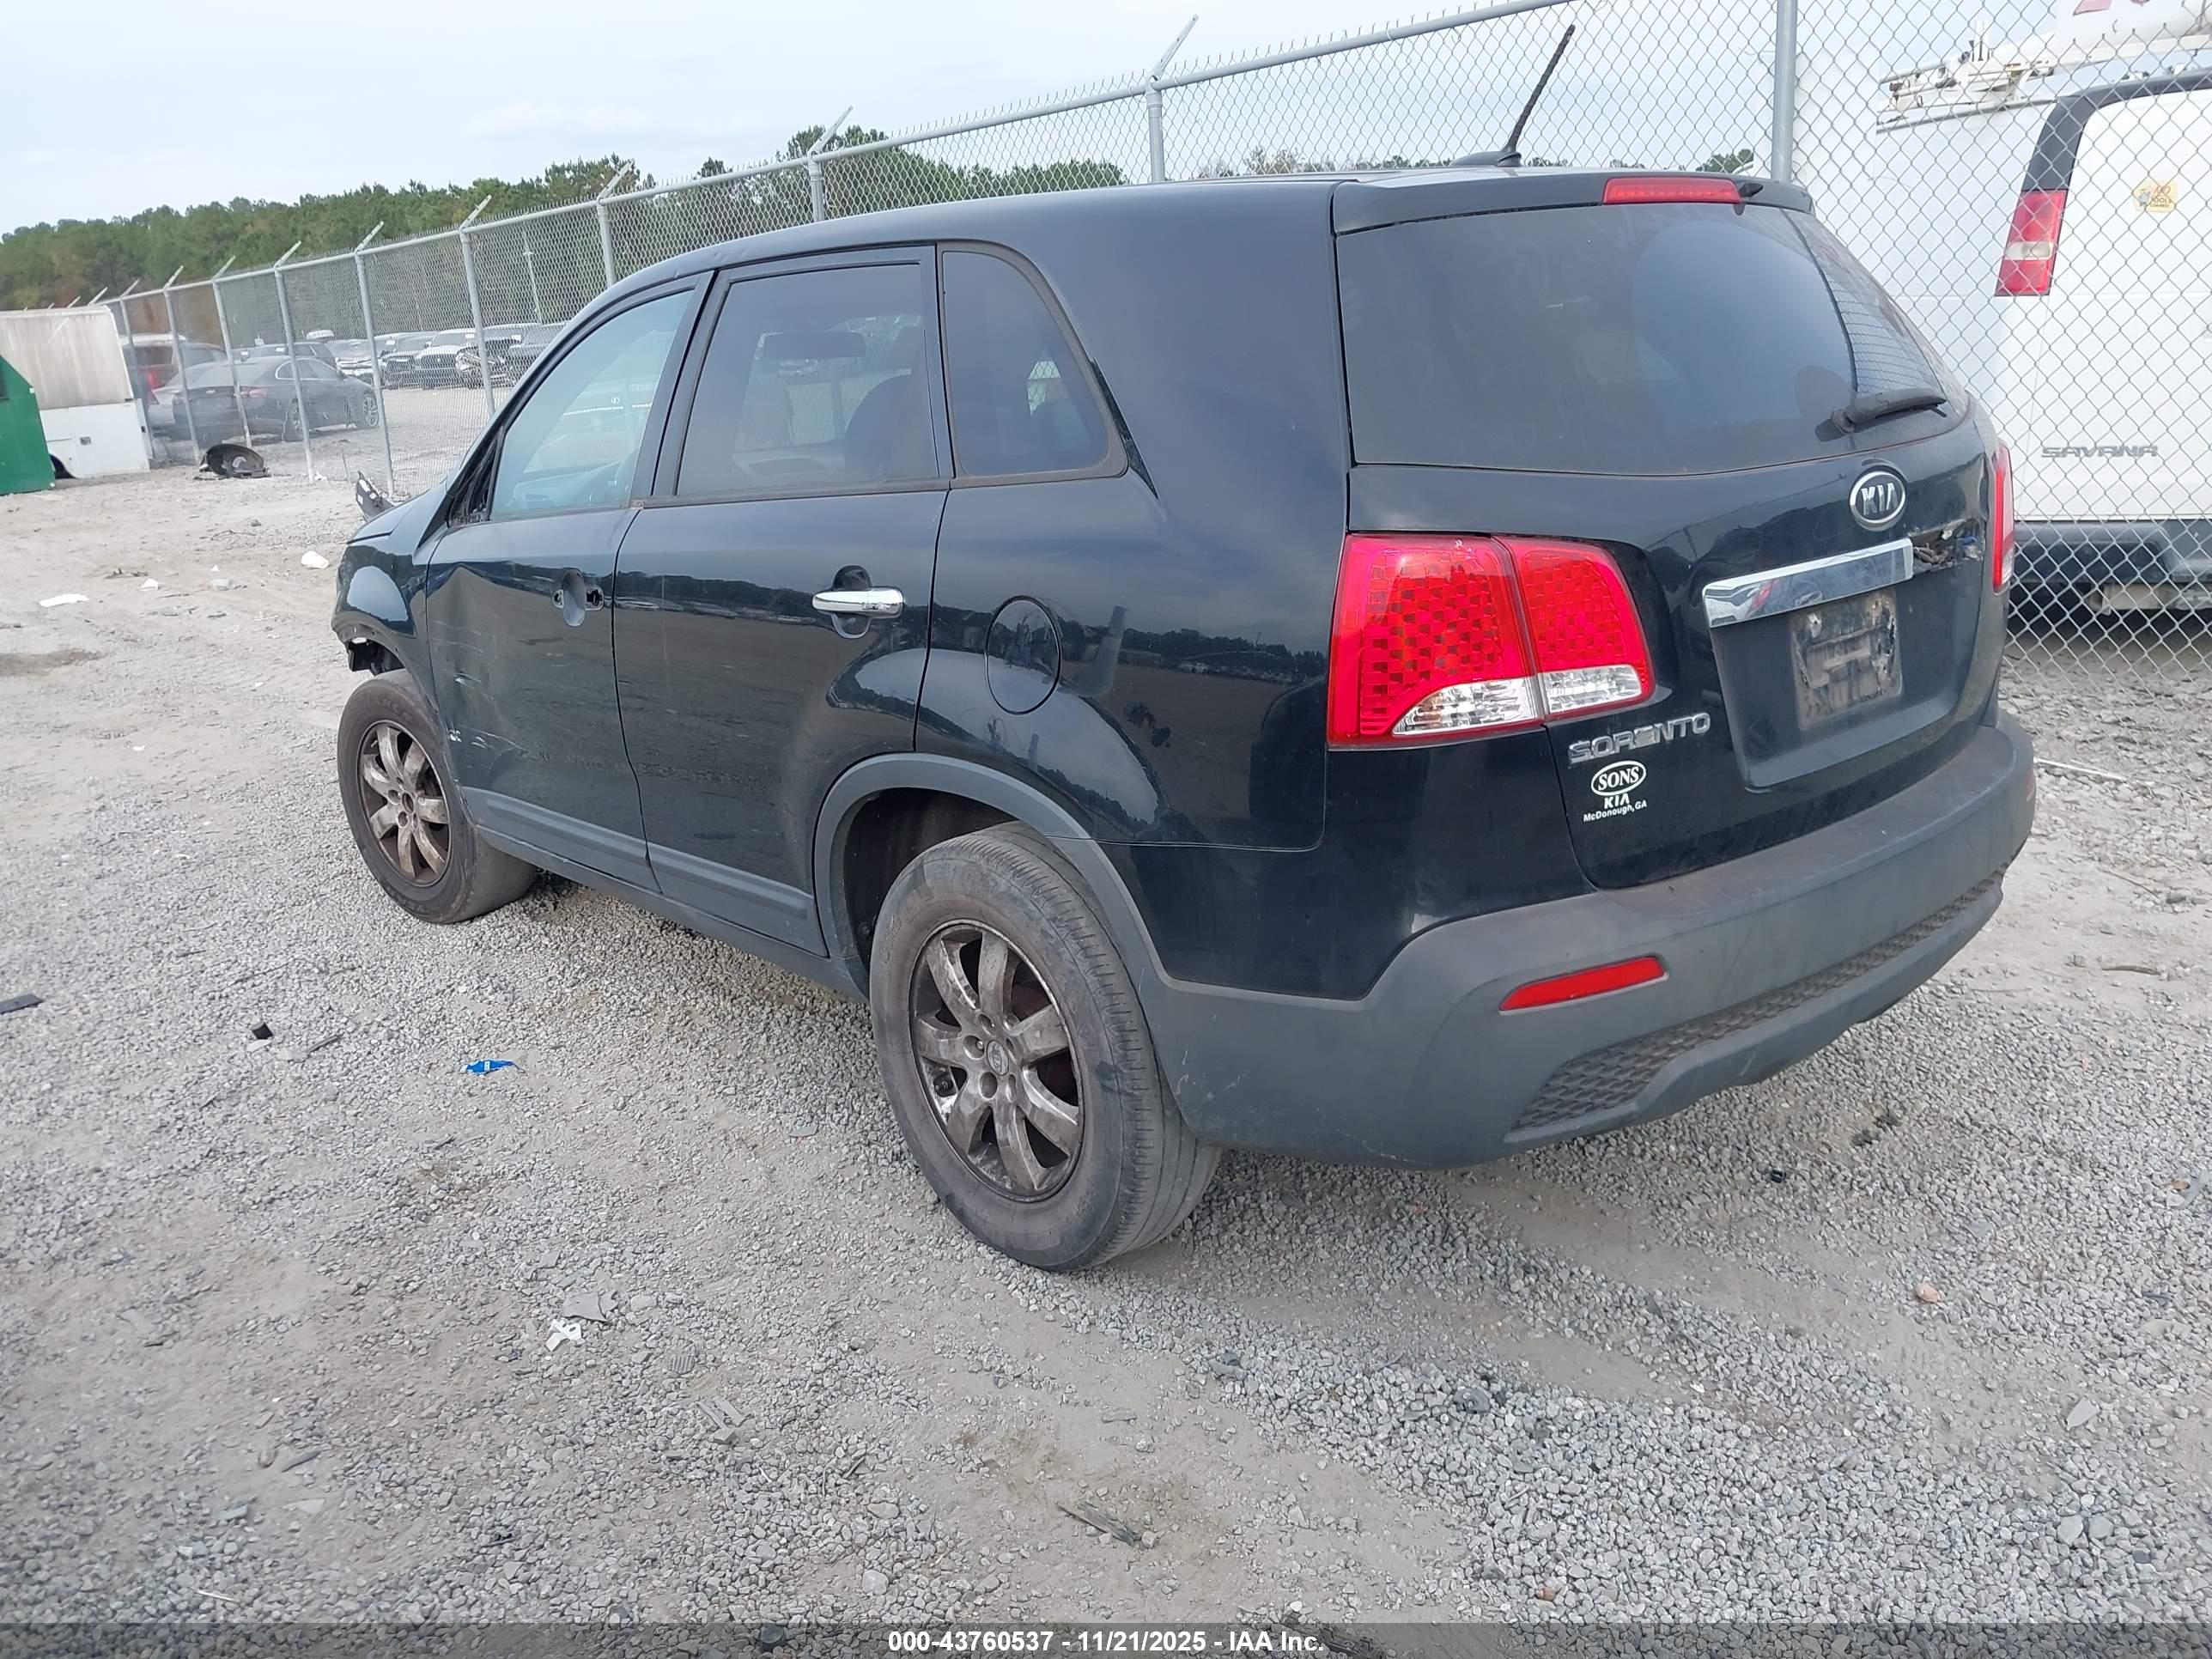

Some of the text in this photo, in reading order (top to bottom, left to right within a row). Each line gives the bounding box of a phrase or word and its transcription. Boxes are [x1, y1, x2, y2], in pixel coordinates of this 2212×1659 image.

[2041, 446, 2158, 458] SAVANA
[1861, 483, 1899, 515] KIA
[1568, 713, 1711, 763] SORENTO
[1597, 766, 1639, 790] SONS
[1604, 793, 1630, 809] KIA
